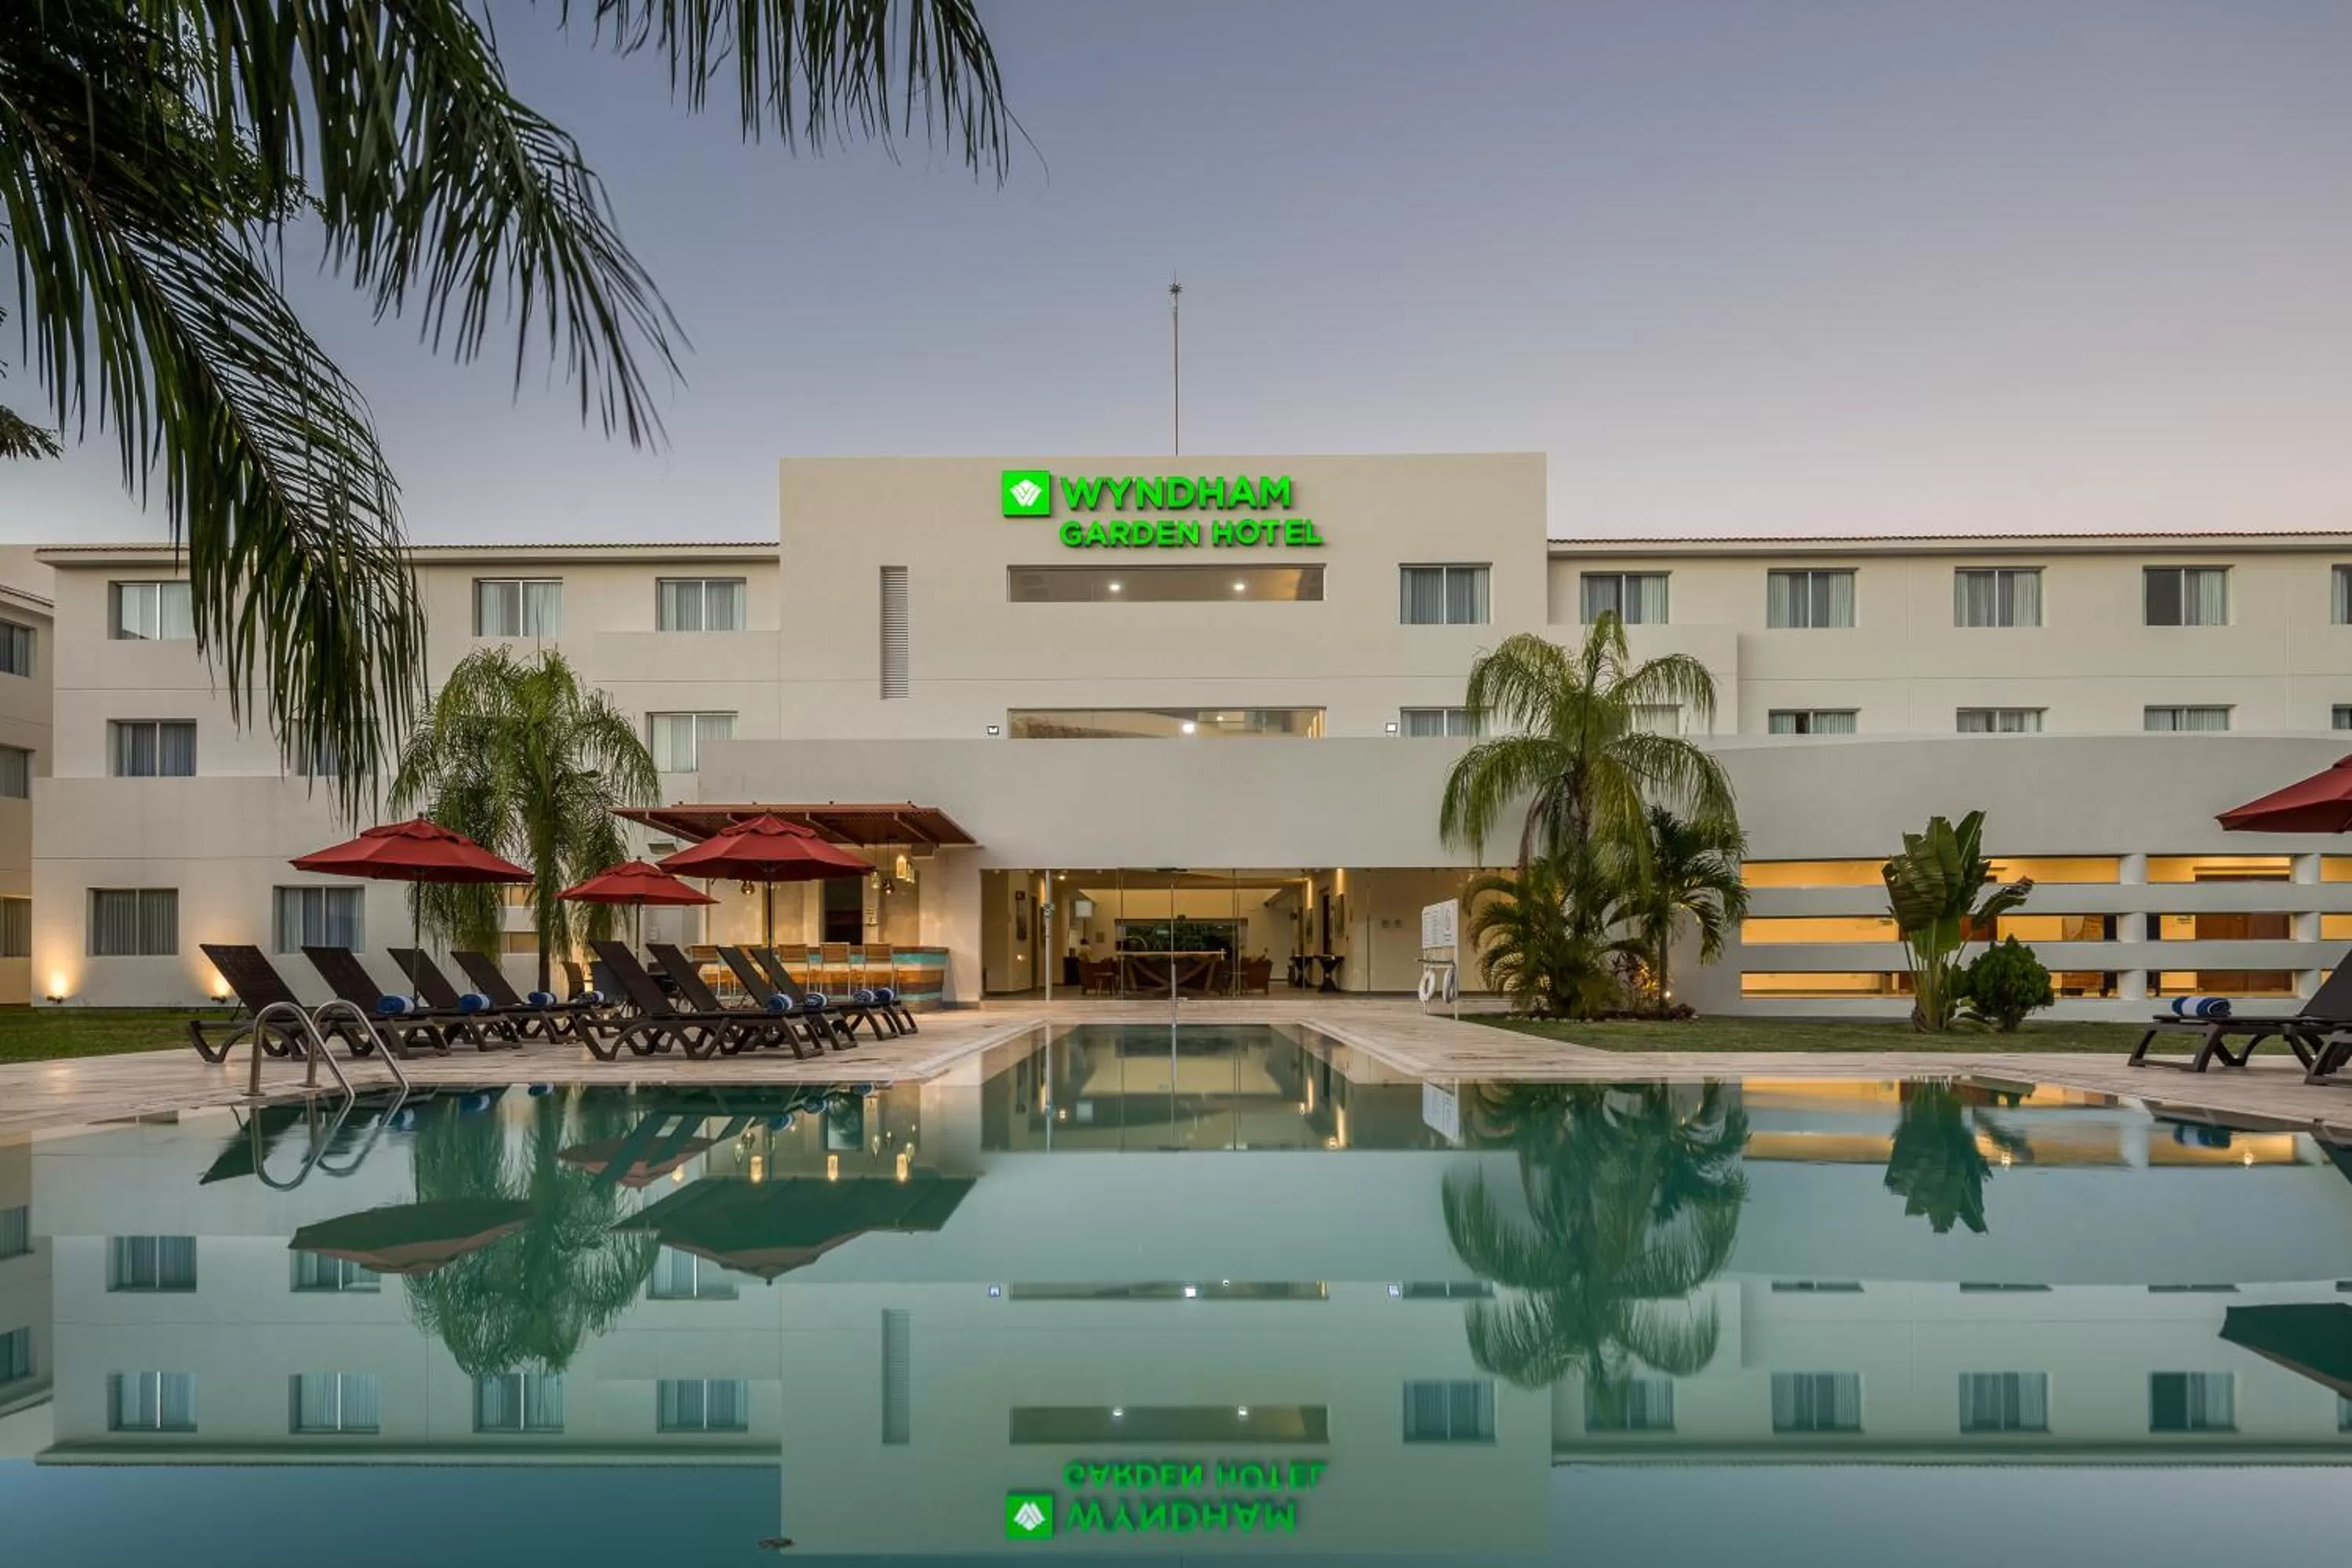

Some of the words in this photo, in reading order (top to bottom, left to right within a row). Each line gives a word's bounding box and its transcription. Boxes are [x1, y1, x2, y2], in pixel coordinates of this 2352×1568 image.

[1060, 476, 1292, 510] WYNDHAM
[1058, 519, 1200, 547] GARDEN
[1210, 517, 1324, 546] HOTEL
